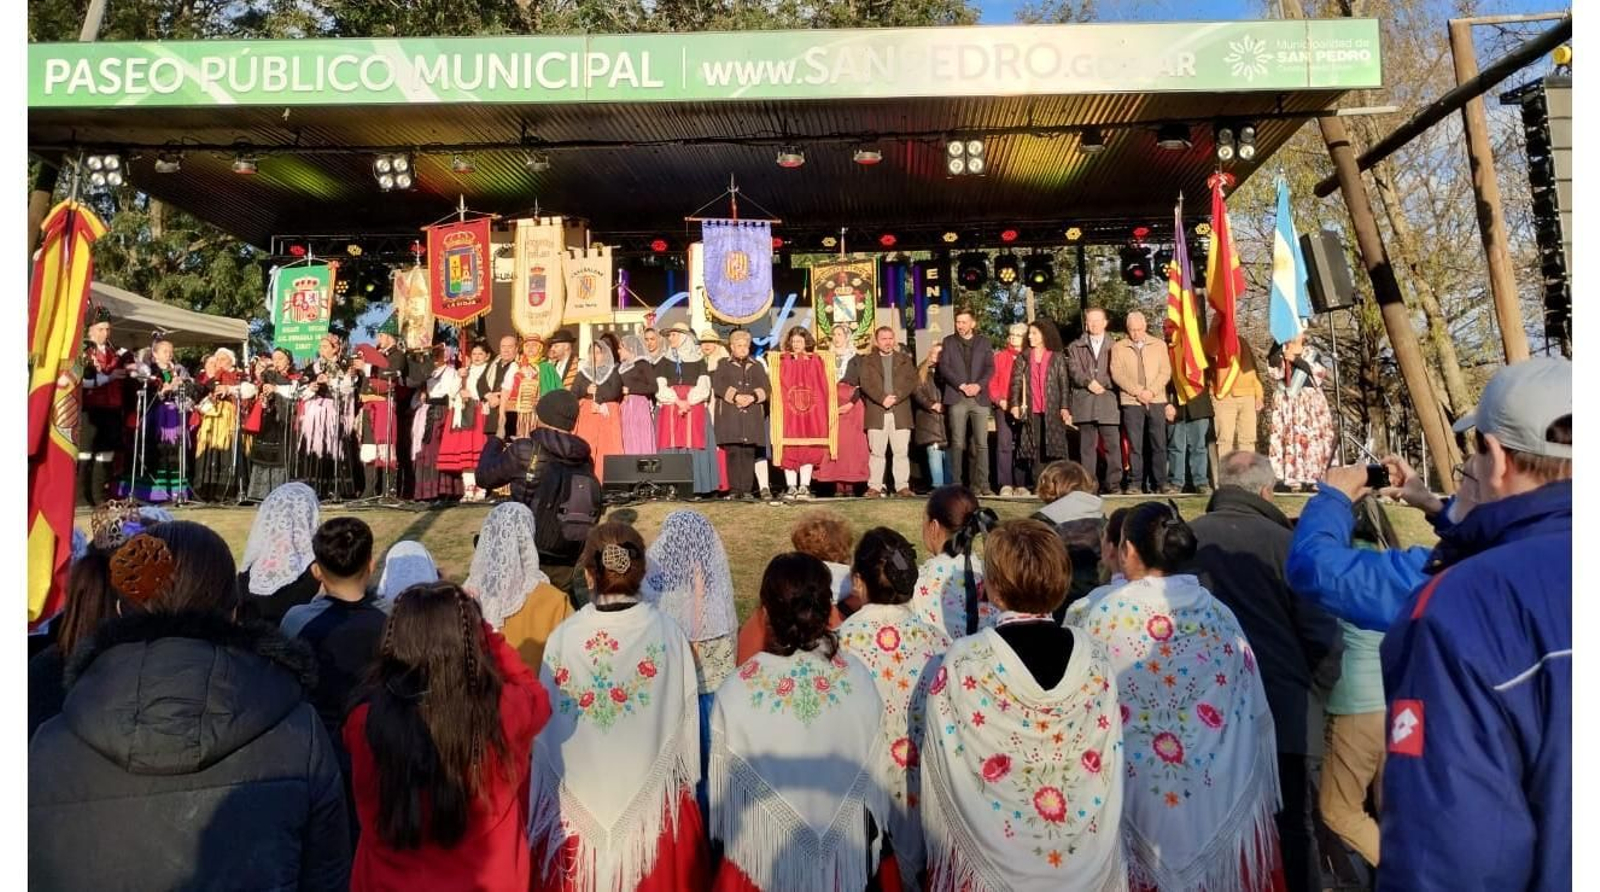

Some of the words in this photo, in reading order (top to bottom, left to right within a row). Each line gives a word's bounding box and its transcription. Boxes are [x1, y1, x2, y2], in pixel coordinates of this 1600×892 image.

[1276, 39, 1352, 50] Municpalidad
[1276, 51, 1309, 64] SAN
[1316, 49, 1371, 62] PEDRO
[44, 57, 185, 95] PASEO
[201, 47, 396, 93] PÚBLICO
[411, 51, 664, 90] MUNICIPAL
